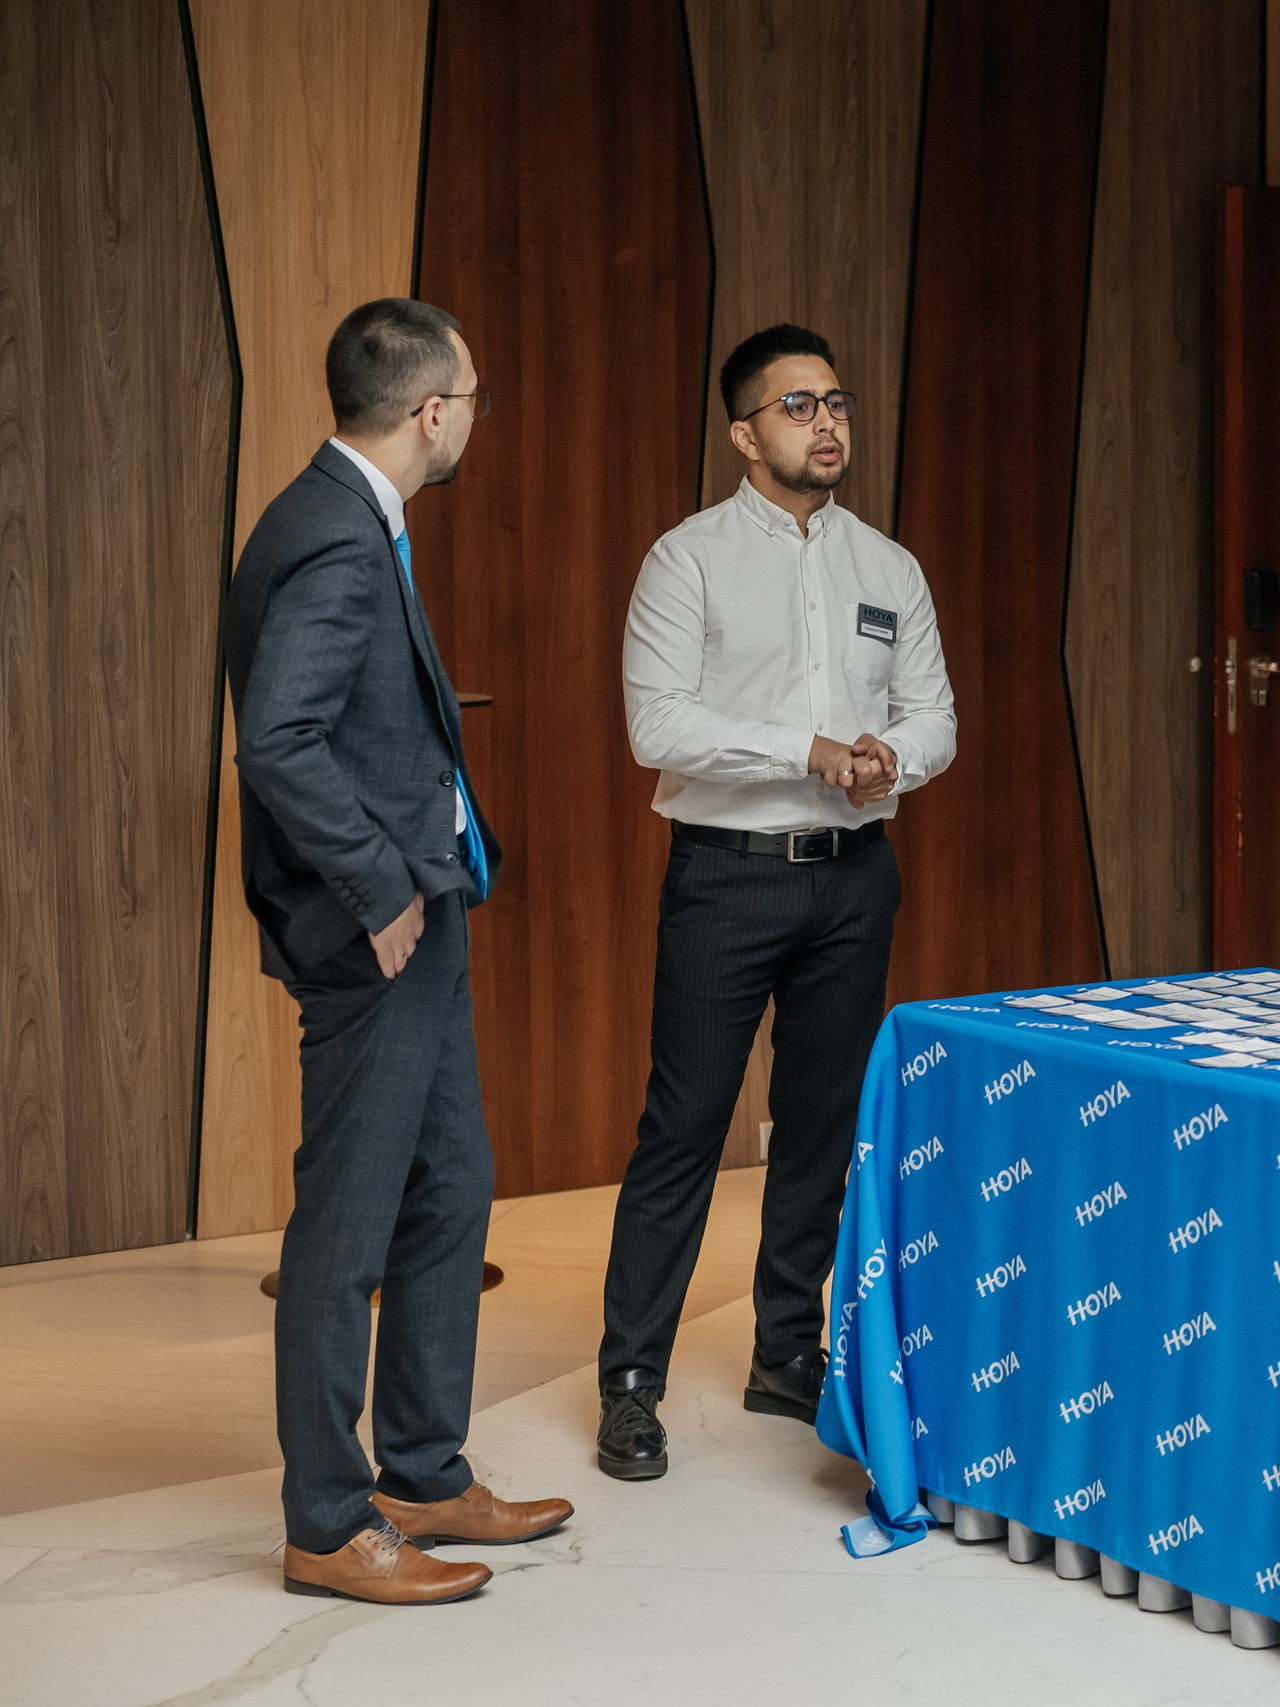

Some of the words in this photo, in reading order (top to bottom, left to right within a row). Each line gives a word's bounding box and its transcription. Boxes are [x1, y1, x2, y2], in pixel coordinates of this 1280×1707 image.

[863, 606, 894, 623] HOYA
[901, 1041, 947, 1086] HOYA
[984, 1060, 1036, 1105] HOYA
[1079, 1080, 1131, 1127] HOYA
[1173, 1103, 1229, 1151] HOYA
[900, 1136, 944, 1180] HOYA
[980, 1157, 1033, 1202] HOYA
[1075, 1181, 1128, 1227] HOYA
[1168, 1208, 1223, 1254] HOYA
[857, 1238, 888, 1300] HOY
[976, 1254, 1027, 1298] HOYA
[1066, 1281, 1122, 1326] HOYA
[833, 1301, 859, 1381] HOYA
[1163, 1311, 1217, 1356] HOYA
[971, 1351, 1020, 1393] HOYA
[1059, 1381, 1114, 1424] HOYA
[1155, 1414, 1211, 1456] HOYA
[963, 1446, 1016, 1487] HOYA
[1054, 1479, 1106, 1520] HOYA
[1148, 1514, 1204, 1555] HOYA
